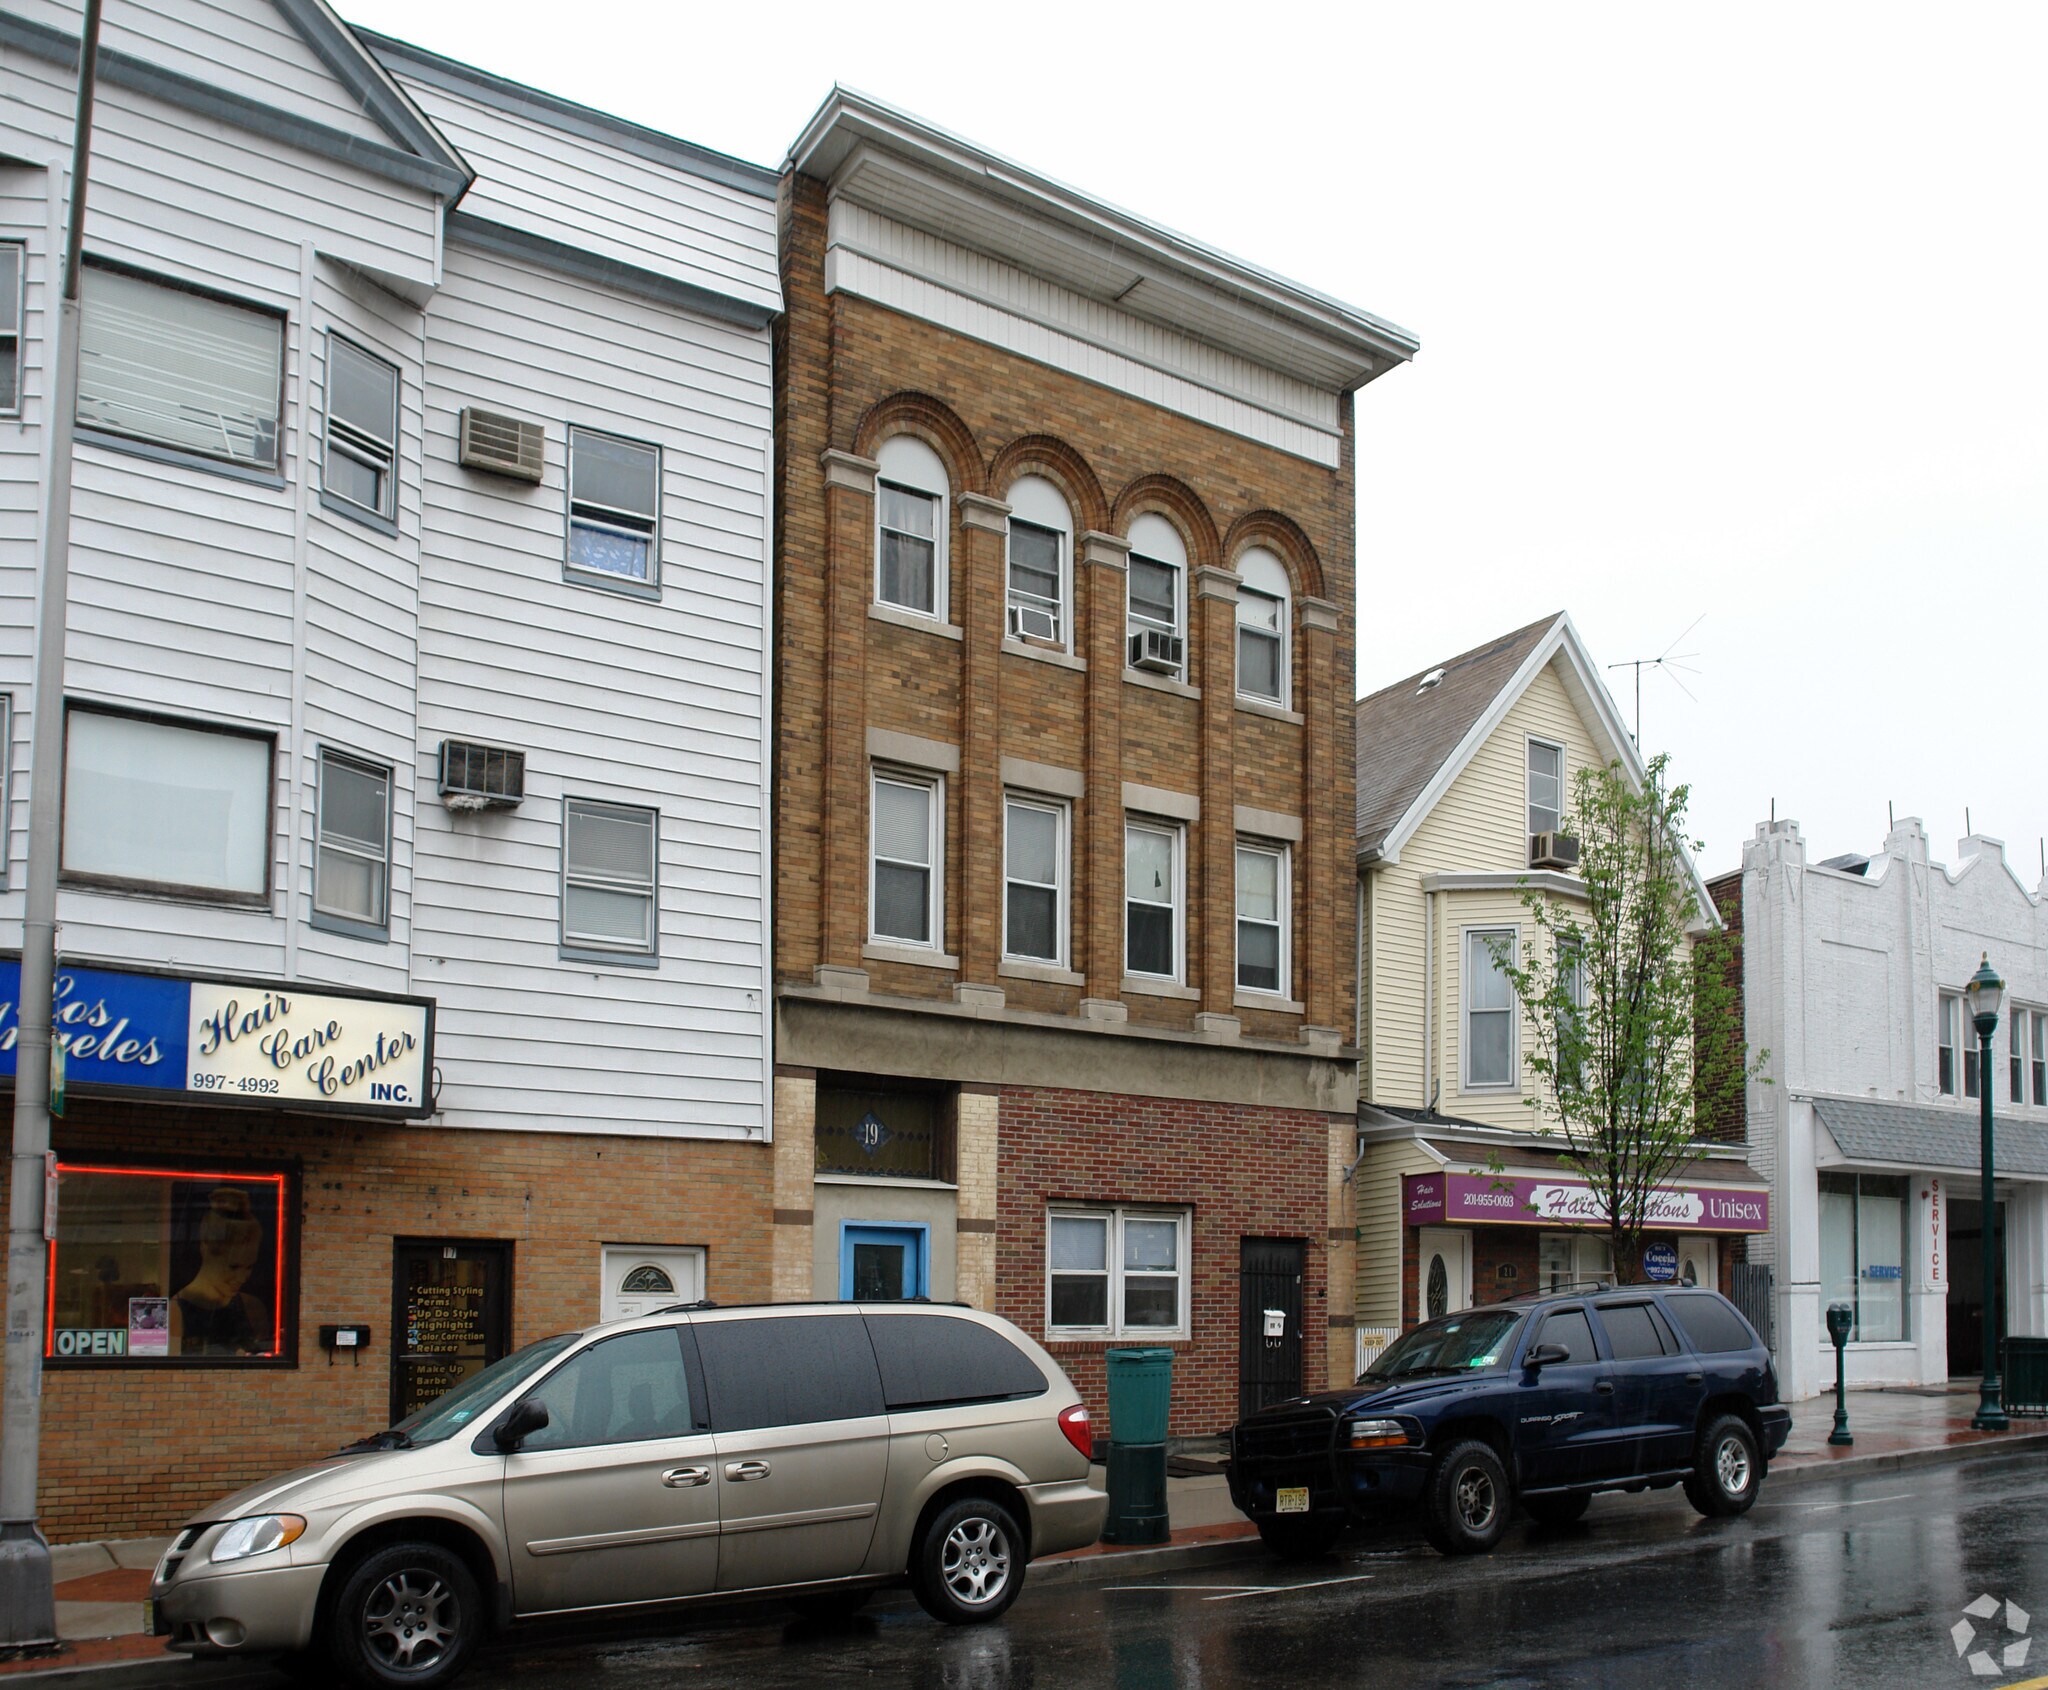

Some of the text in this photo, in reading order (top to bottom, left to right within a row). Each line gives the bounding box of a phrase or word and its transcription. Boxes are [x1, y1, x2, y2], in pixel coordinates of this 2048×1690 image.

[0, 1002, 163, 1065] neles
[199, 993, 291, 1055] Hair
[260, 1020, 342, 1069] Care
[307, 1031, 416, 1096] Center
[193, 1073, 279, 1094] 997-4992
[370, 1082, 413, 1102] INC.
[865, 1123, 878, 1145] 19
[1416, 1184, 1434, 1195] Hair
[1411, 1200, 1442, 1211] Solutions
[1546, 1188, 1690, 1218] Hair tions
[1710, 1197, 1762, 1220] Unisex
[417, 1286, 484, 1296] Cutting Styling
[417, 1298, 450, 1306] Perms
[417, 1309, 431, 1319] Up
[452, 1309, 479, 1319] Style
[417, 1321, 473, 1331] Highlights
[441, 1332, 484, 1340] Correction
[57, 1331, 123, 1355] OPEN
[416, 1344, 458, 1352] Relaxer
[416, 1365, 464, 1375] Make Up
